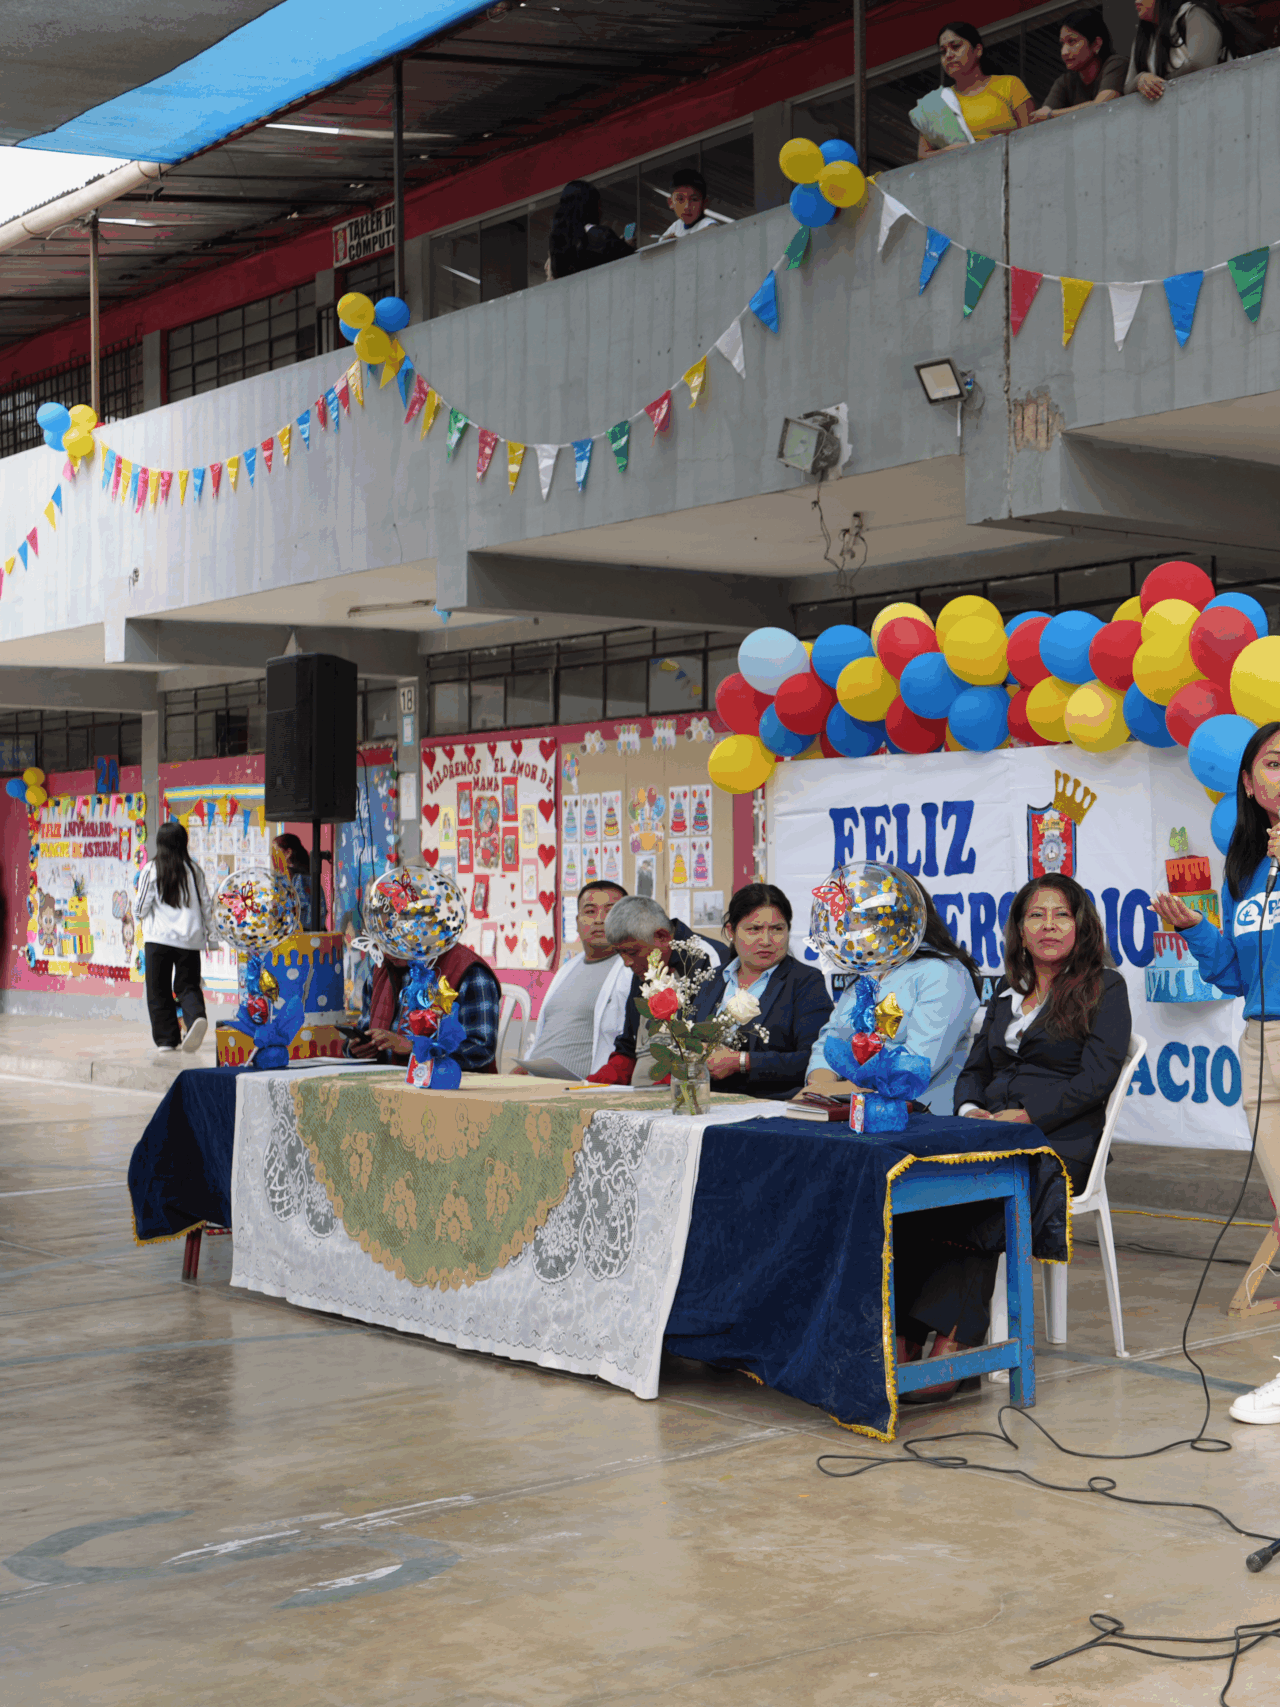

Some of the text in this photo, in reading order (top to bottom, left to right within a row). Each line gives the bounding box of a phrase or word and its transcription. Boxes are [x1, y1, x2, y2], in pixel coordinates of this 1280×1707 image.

[348, 210, 382, 242] TALLER
[402, 689, 413, 711] 18
[494, 757, 507, 773] EL
[510, 760, 538, 780] AMOR
[540, 767, 554, 793] DE
[829, 800, 976, 878] FELIZ
